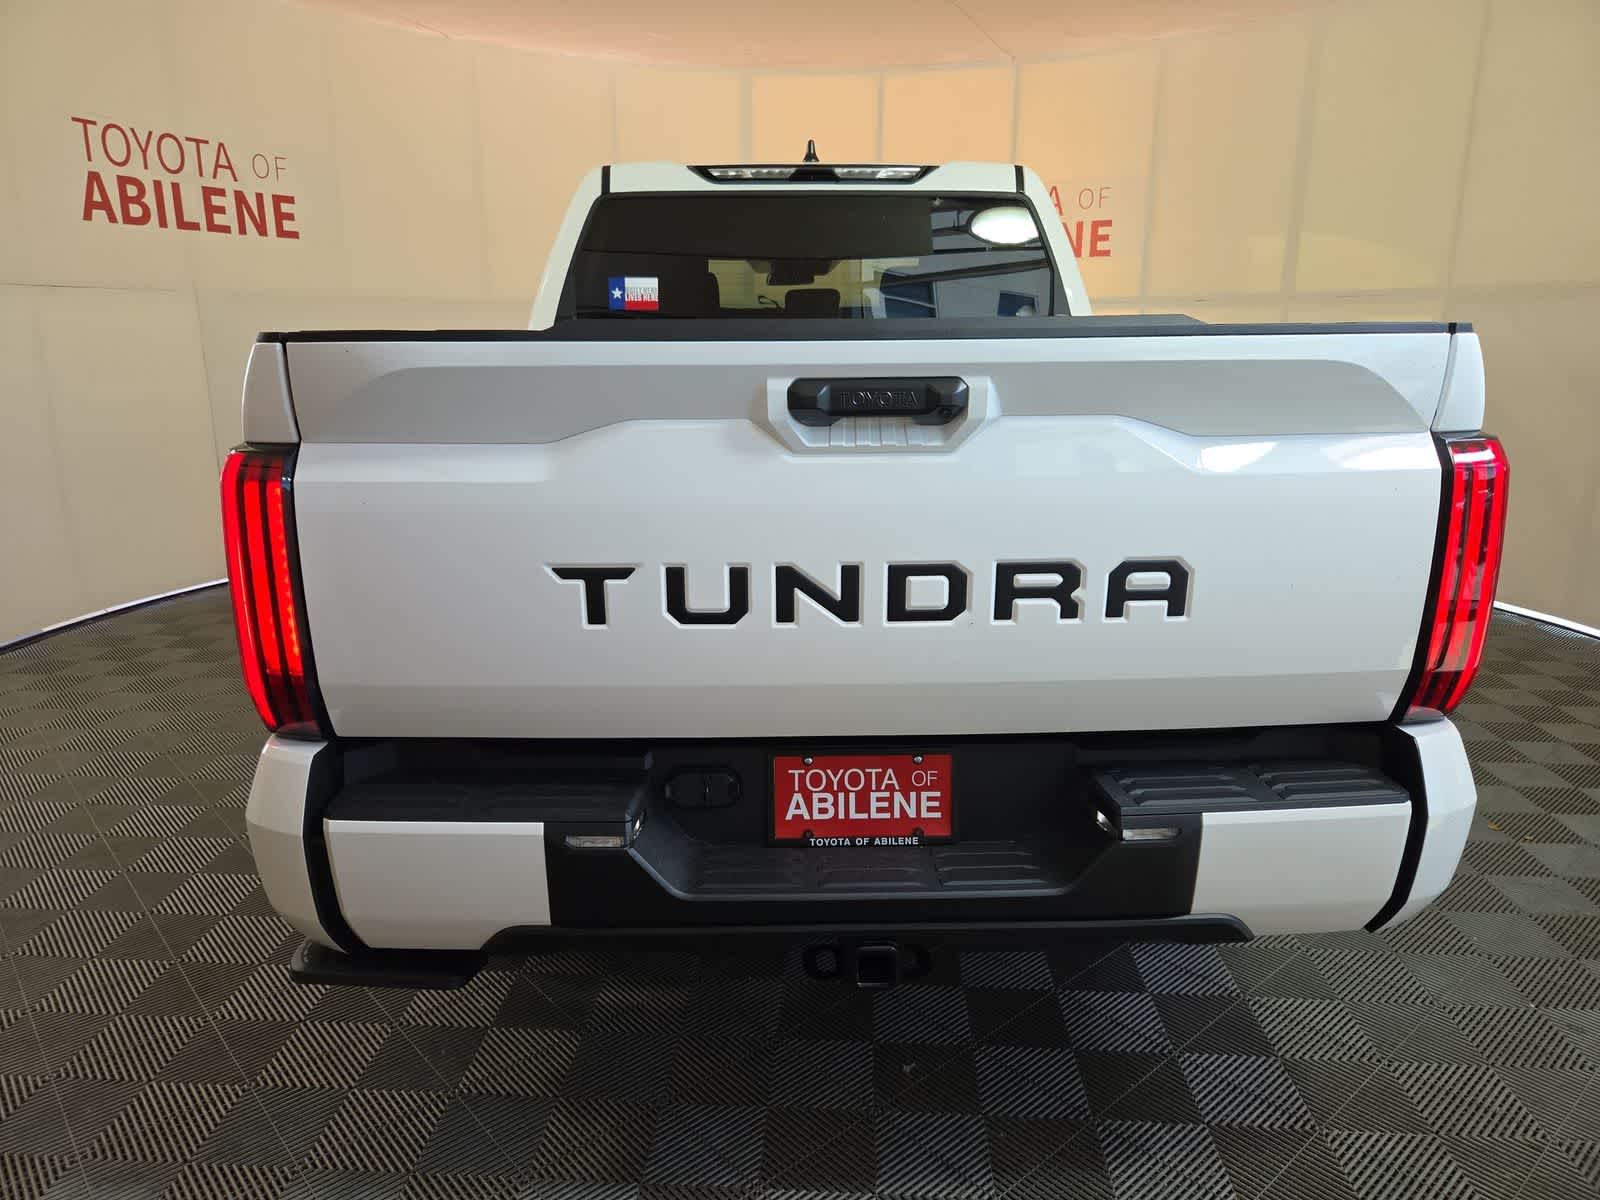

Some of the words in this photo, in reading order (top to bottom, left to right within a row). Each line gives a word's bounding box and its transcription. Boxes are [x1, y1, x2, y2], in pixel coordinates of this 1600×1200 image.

[71, 116, 238, 182] TOYOTA
[252, 153, 287, 181] OF
[82, 170, 300, 240] ABILENE
[1078, 186, 1112, 209] OF
[839, 390, 922, 408] TOYOTA
[545, 557, 1194, 629] TUNDRA
[788, 768, 899, 791] TOYOTA
[911, 770, 938, 787] OF
[785, 791, 942, 820] ABILENE
[810, 838, 850, 846] TOYOTA
[856, 837, 869, 846] OF
[874, 836, 919, 845] ABILENE
